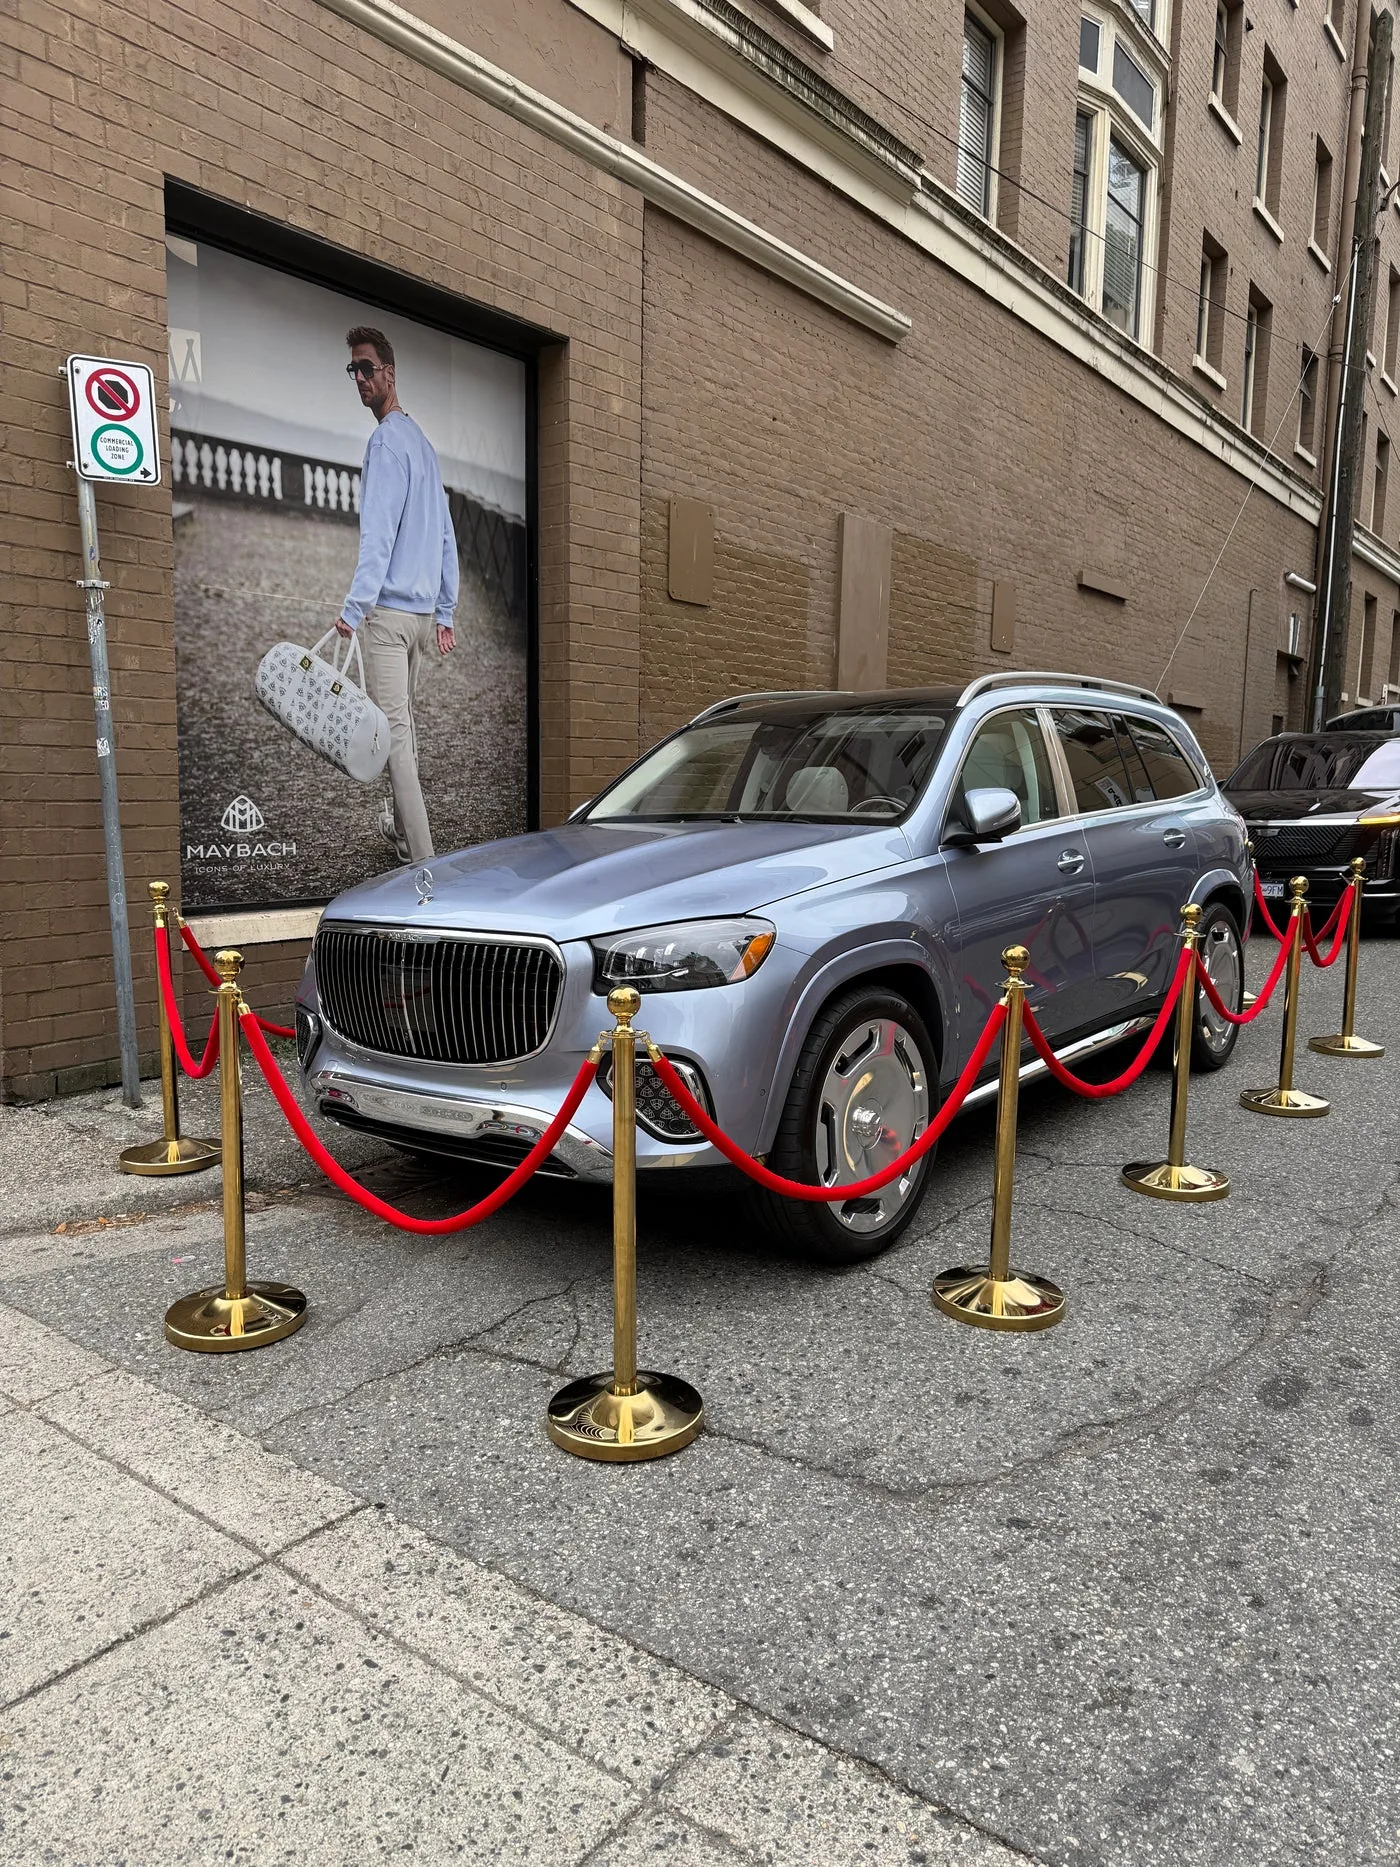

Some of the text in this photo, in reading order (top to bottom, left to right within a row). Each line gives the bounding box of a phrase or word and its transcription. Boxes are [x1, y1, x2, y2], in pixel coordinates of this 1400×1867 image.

[100, 437, 134, 446] COMMERCIAL
[105, 445, 129, 453] LOADING
[186, 843, 297, 859] MAYBACH
[195, 863, 290, 875] ICONS OF LUXURY
